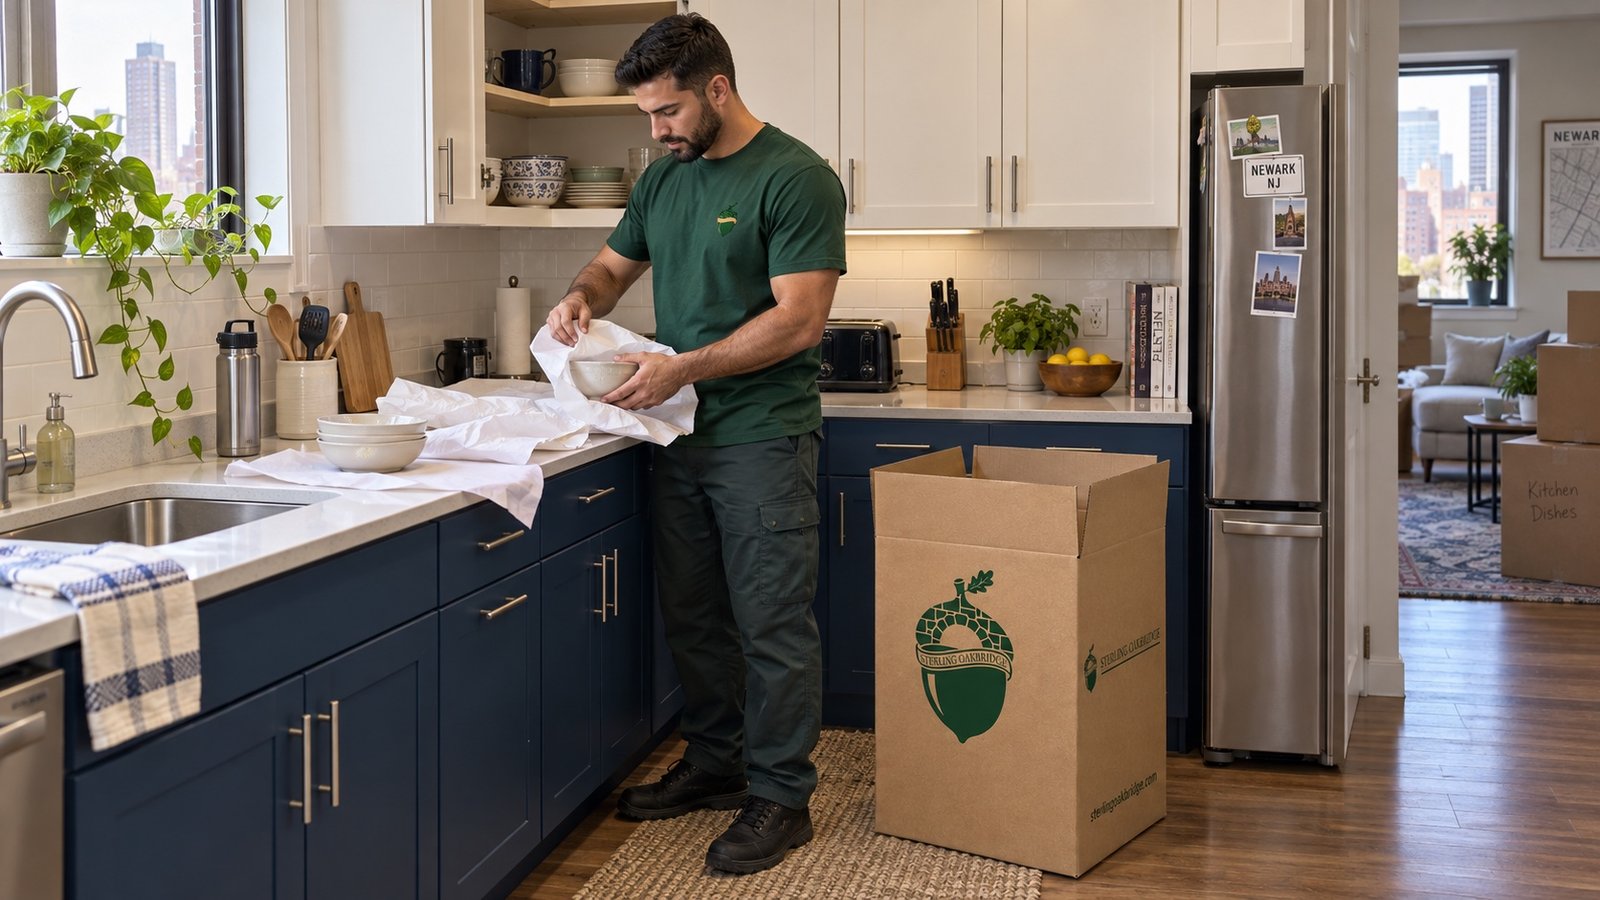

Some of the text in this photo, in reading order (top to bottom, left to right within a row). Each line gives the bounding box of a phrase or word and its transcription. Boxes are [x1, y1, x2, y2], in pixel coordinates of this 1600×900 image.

[1554, 130, 1599, 142] NEWAR
[1251, 163, 1296, 176] NEWARK
[1267, 177, 1281, 188] NJ
[1528, 480, 1579, 499] Kitchen
[1531, 504, 1577, 522] Dishes
[920, 652, 1008, 668] STERLING OAKBRIDGE
